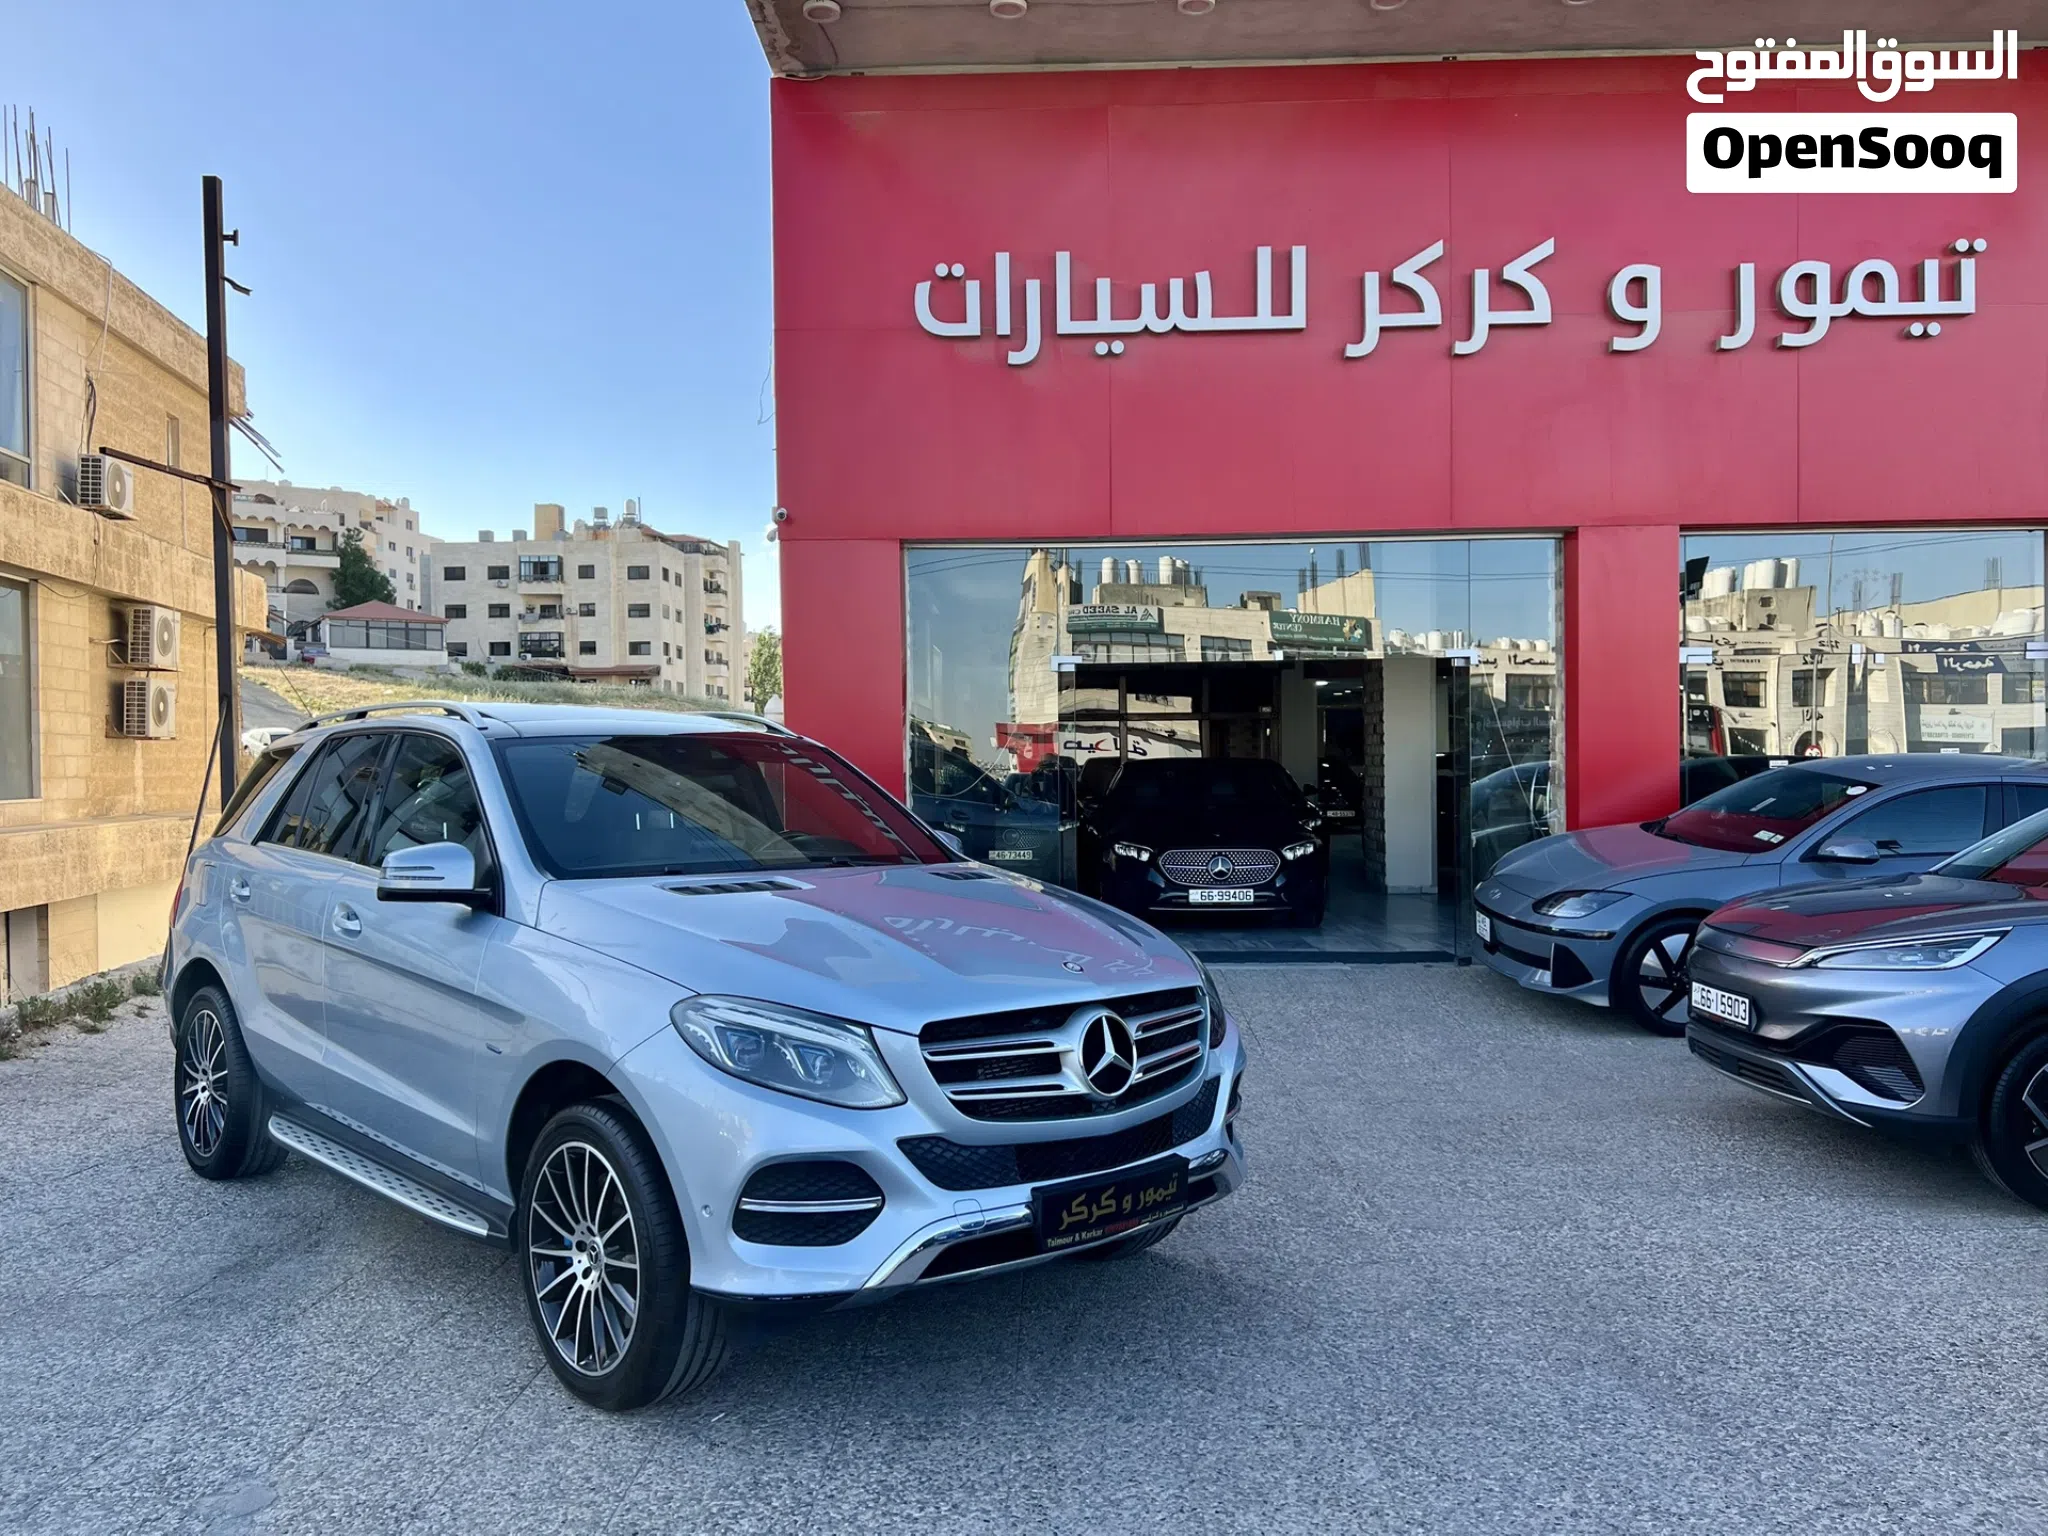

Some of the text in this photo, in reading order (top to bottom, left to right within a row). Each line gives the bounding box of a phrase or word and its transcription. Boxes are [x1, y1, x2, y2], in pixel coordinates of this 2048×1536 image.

[913, 236, 1987, 366] تيمور و كركر للسيارات
[1058, 1185, 1117, 1231] كركر
[1122, 1193, 1132, 1214] و
[1136, 1172, 1179, 1211] تيمور
[1074, 1233, 1080, 1242] &
